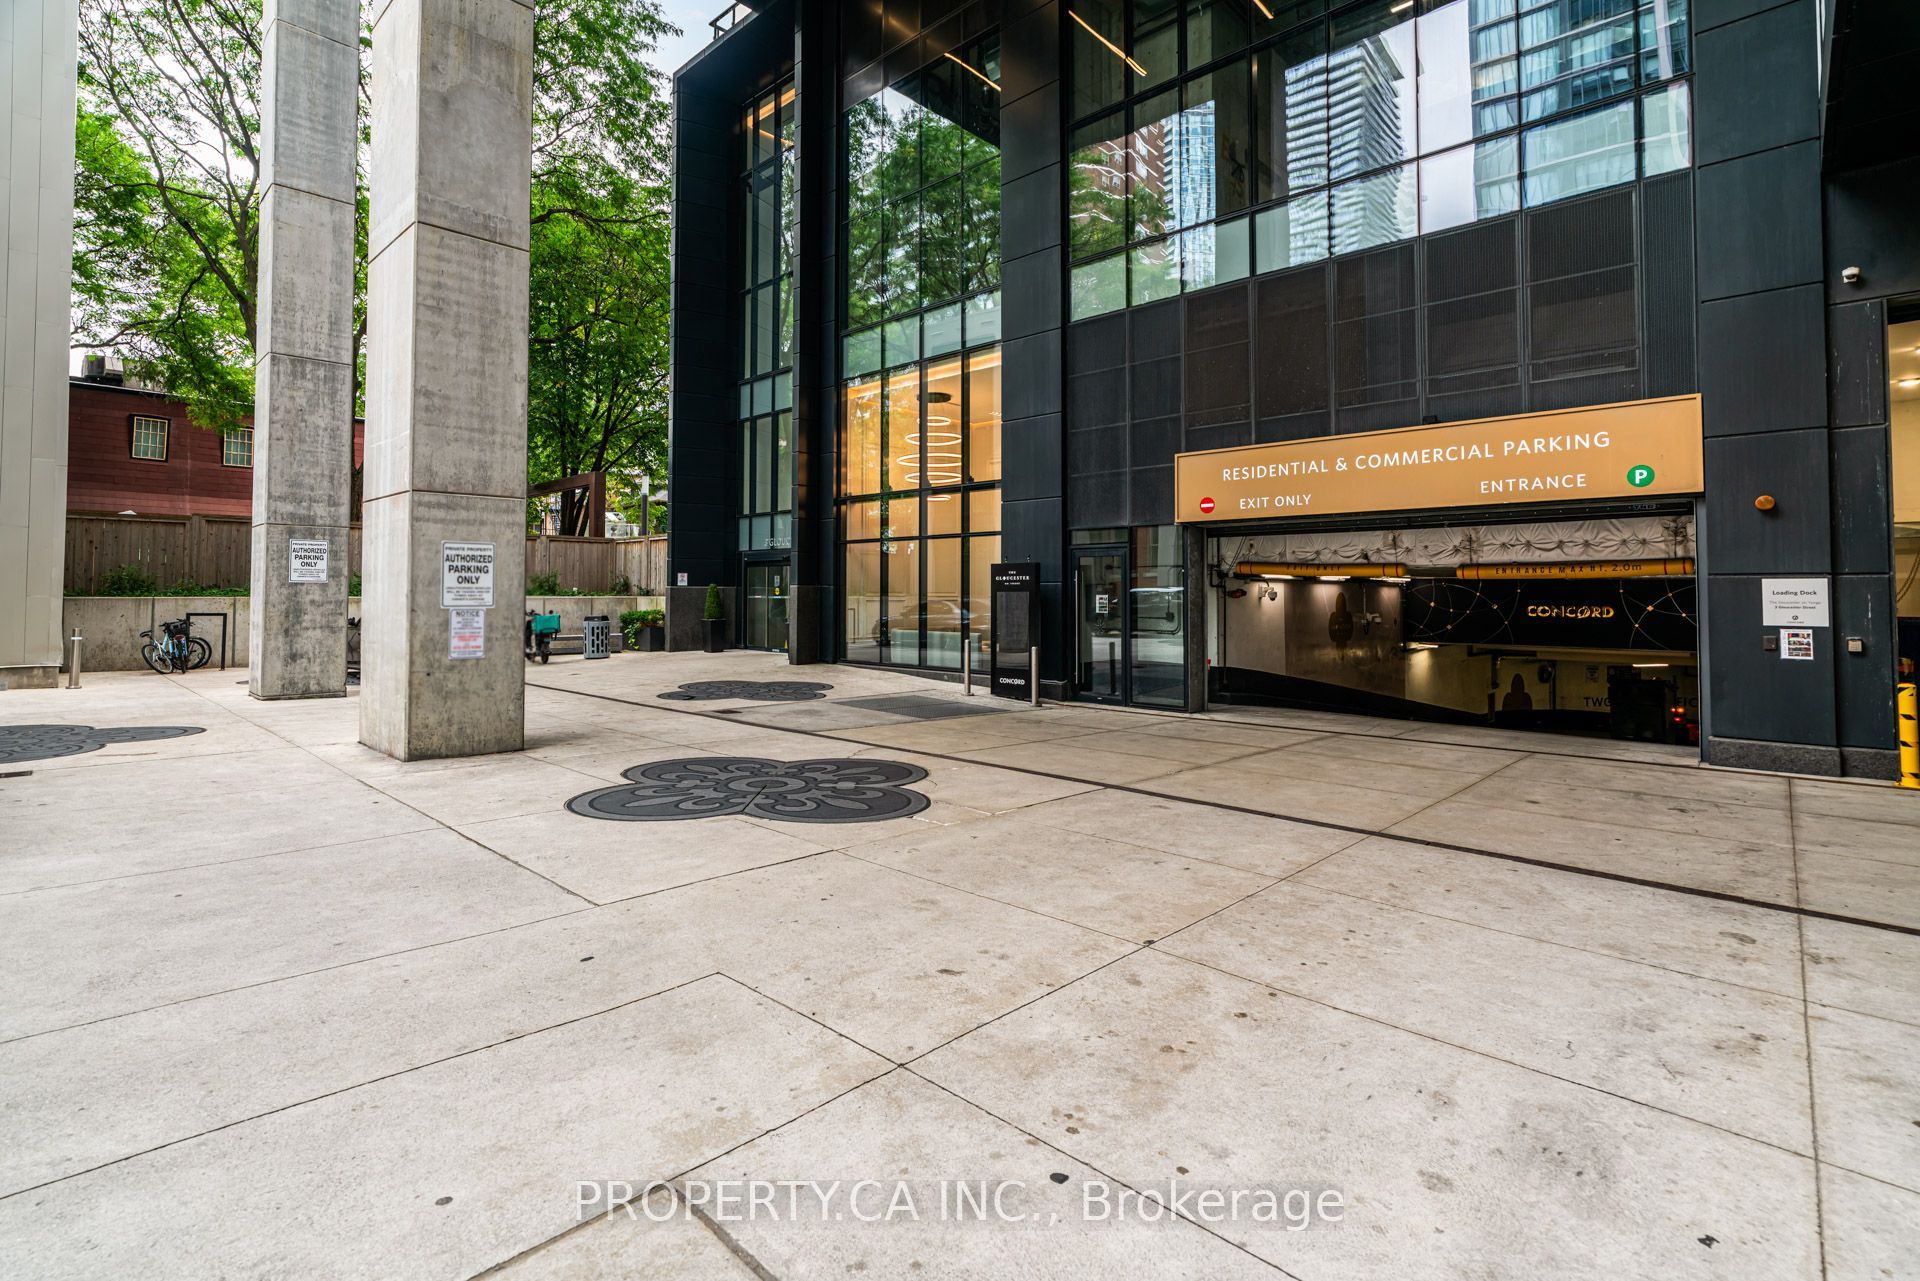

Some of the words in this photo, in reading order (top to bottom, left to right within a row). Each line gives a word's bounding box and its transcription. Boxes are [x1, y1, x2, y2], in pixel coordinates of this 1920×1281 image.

[1223, 459, 1328, 481] RESIDENTIAL
[1336, 457, 1348, 471] &
[1355, 443, 1494, 470] COMMERCIAL
[1503, 431, 1611, 456] PARKING
[1635, 469, 1648, 484] P
[1480, 473, 1587, 494] ENTRANCE
[1239, 497, 1269, 510] EXIT
[1275, 494, 1312, 507] ONLY
[445, 554, 493, 563] AUTHORIZED
[448, 565, 489, 574] PARKING
[1495, 567, 1553, 575] ENTRANCE
[457, 575, 480, 584] ONLY
